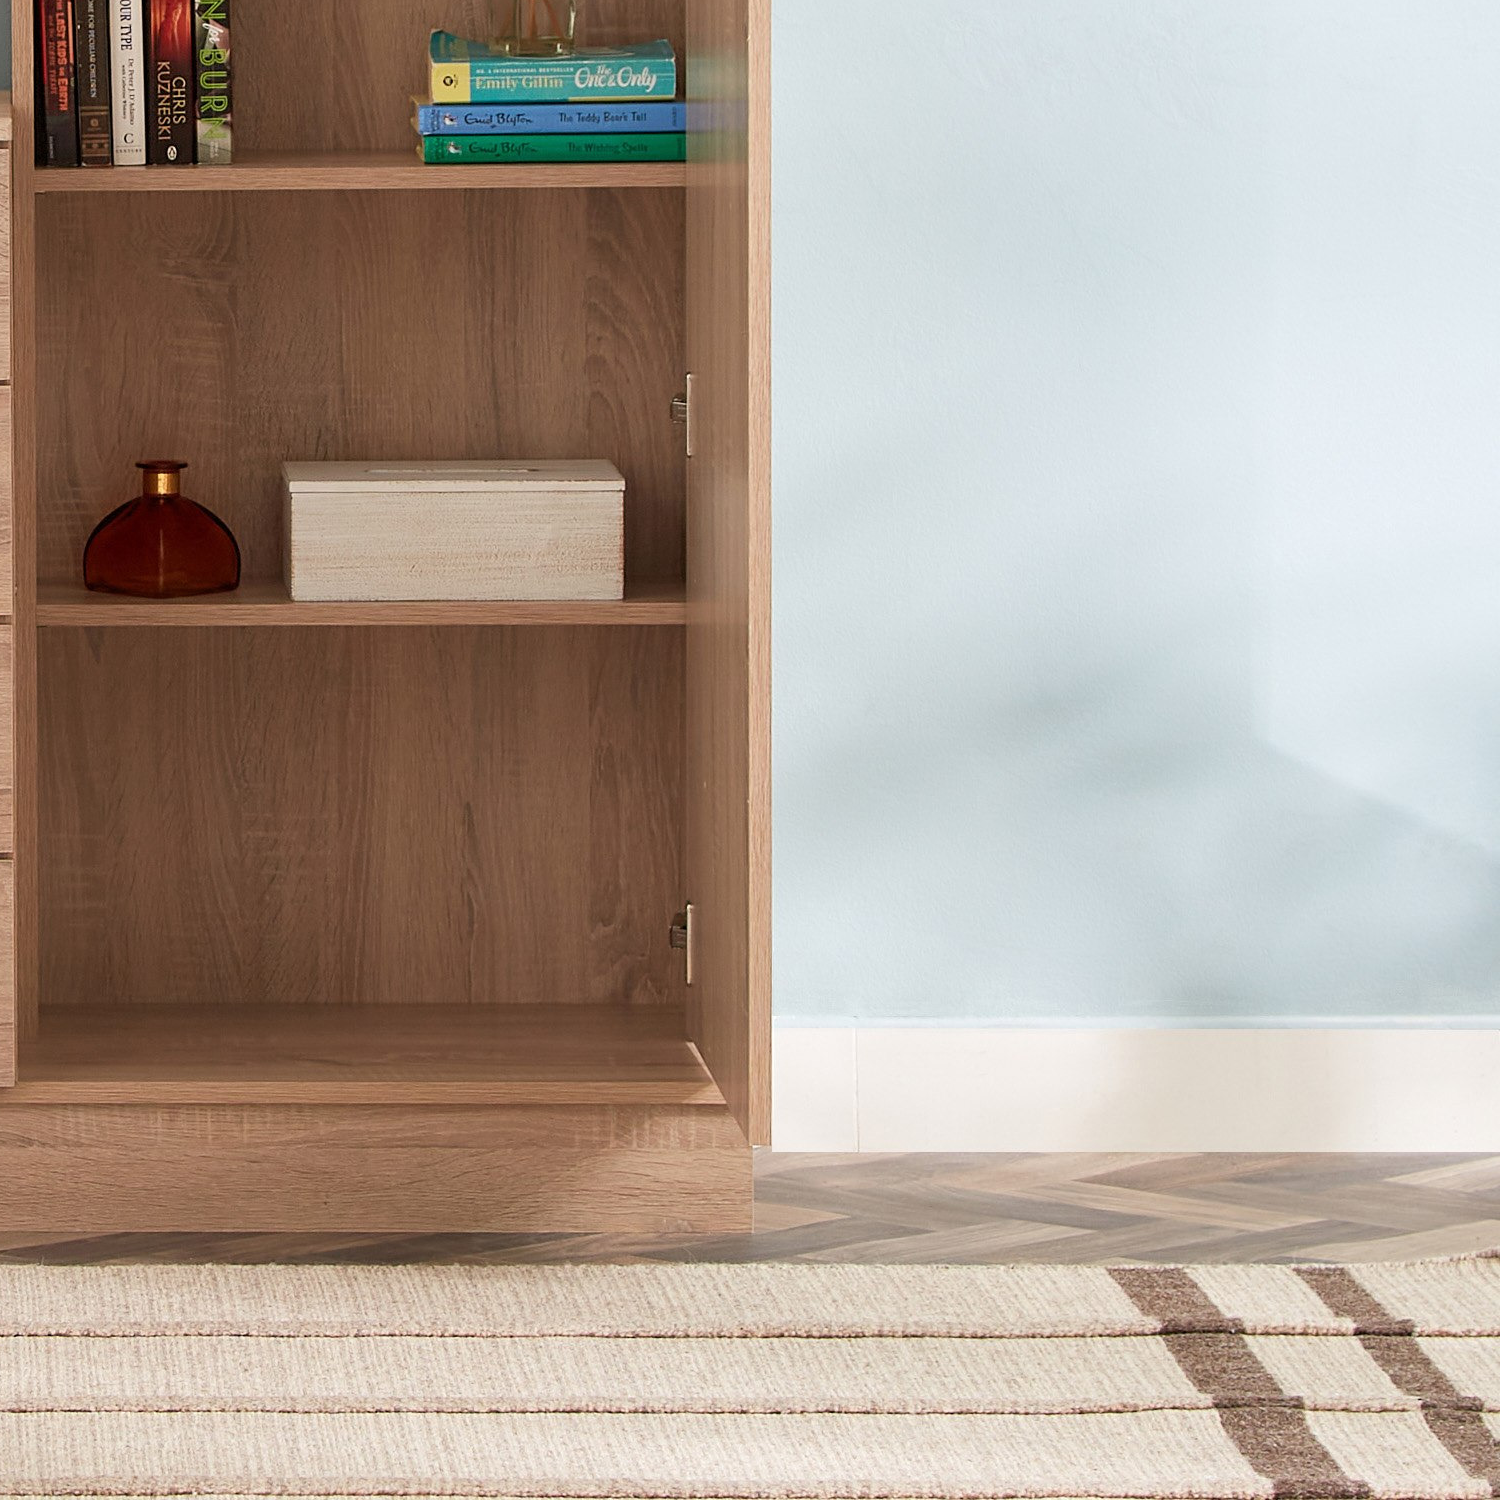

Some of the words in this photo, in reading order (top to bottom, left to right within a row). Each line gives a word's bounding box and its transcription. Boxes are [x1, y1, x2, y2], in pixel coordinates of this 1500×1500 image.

[56, 12, 66, 38] LAST
[120, 24, 132, 51] TYPE
[202, 23, 225, 44] for
[57, 40, 67, 65] KIDS
[89, 64, 97, 98] CHILDREN
[476, 77, 518, 92] Emily
[521, 76, 563, 89] Giffin
[574, 66, 606, 88] One
[617, 66, 657, 92] Only
[58, 78, 68, 111] EARTH
[157, 61, 171, 140] KUZNESKI
[172, 76, 186, 125] CHRIS
[199, 48, 228, 139] BURN
[464, 113, 493, 125] Enid
[496, 112, 533, 126] Blyton
[559, 112, 573, 122] The
[576, 112, 601, 124] Teddy
[469, 141, 498, 154] Enid
[500, 141, 538, 155] Blyton
